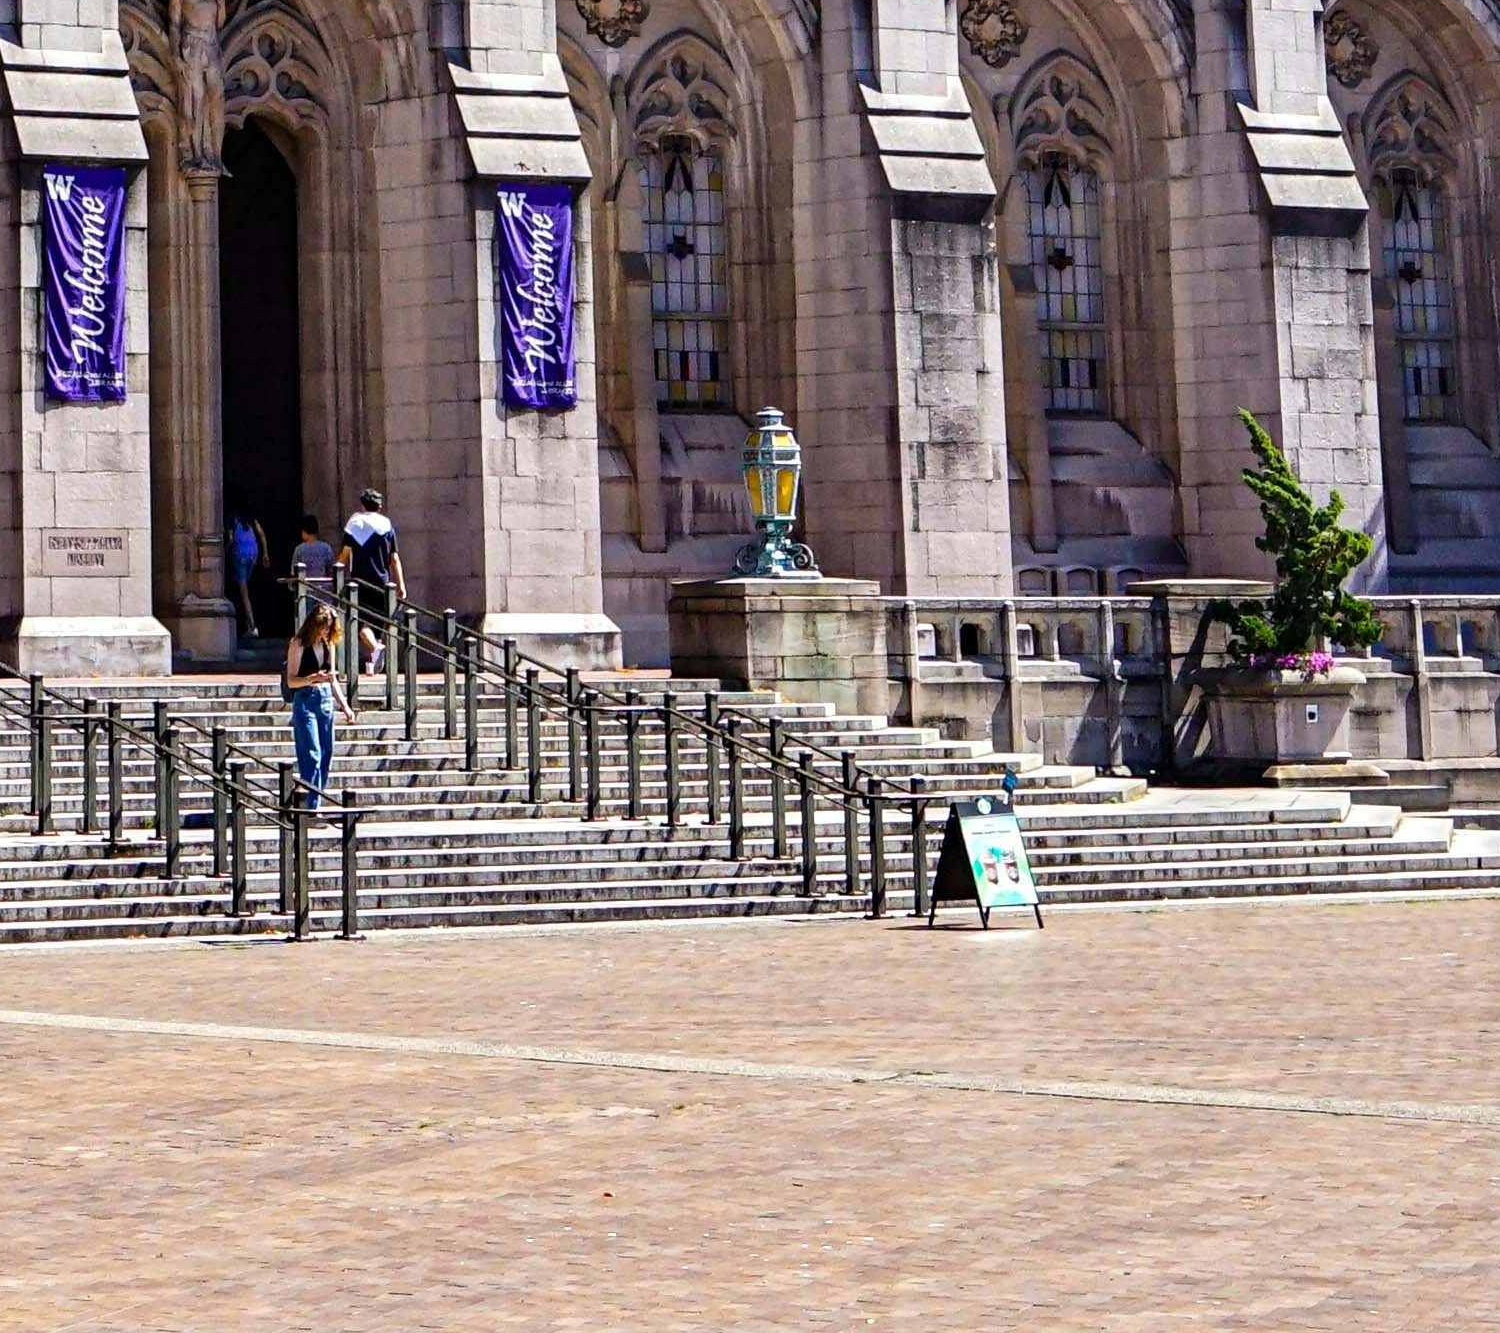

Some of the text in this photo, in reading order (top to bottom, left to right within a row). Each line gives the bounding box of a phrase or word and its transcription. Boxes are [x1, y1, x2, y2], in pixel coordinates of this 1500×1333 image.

[43, 173, 75, 202] W
[497, 191, 527, 218] W
[63, 195, 106, 364] Welcome
[516, 211, 555, 374] Welcome
